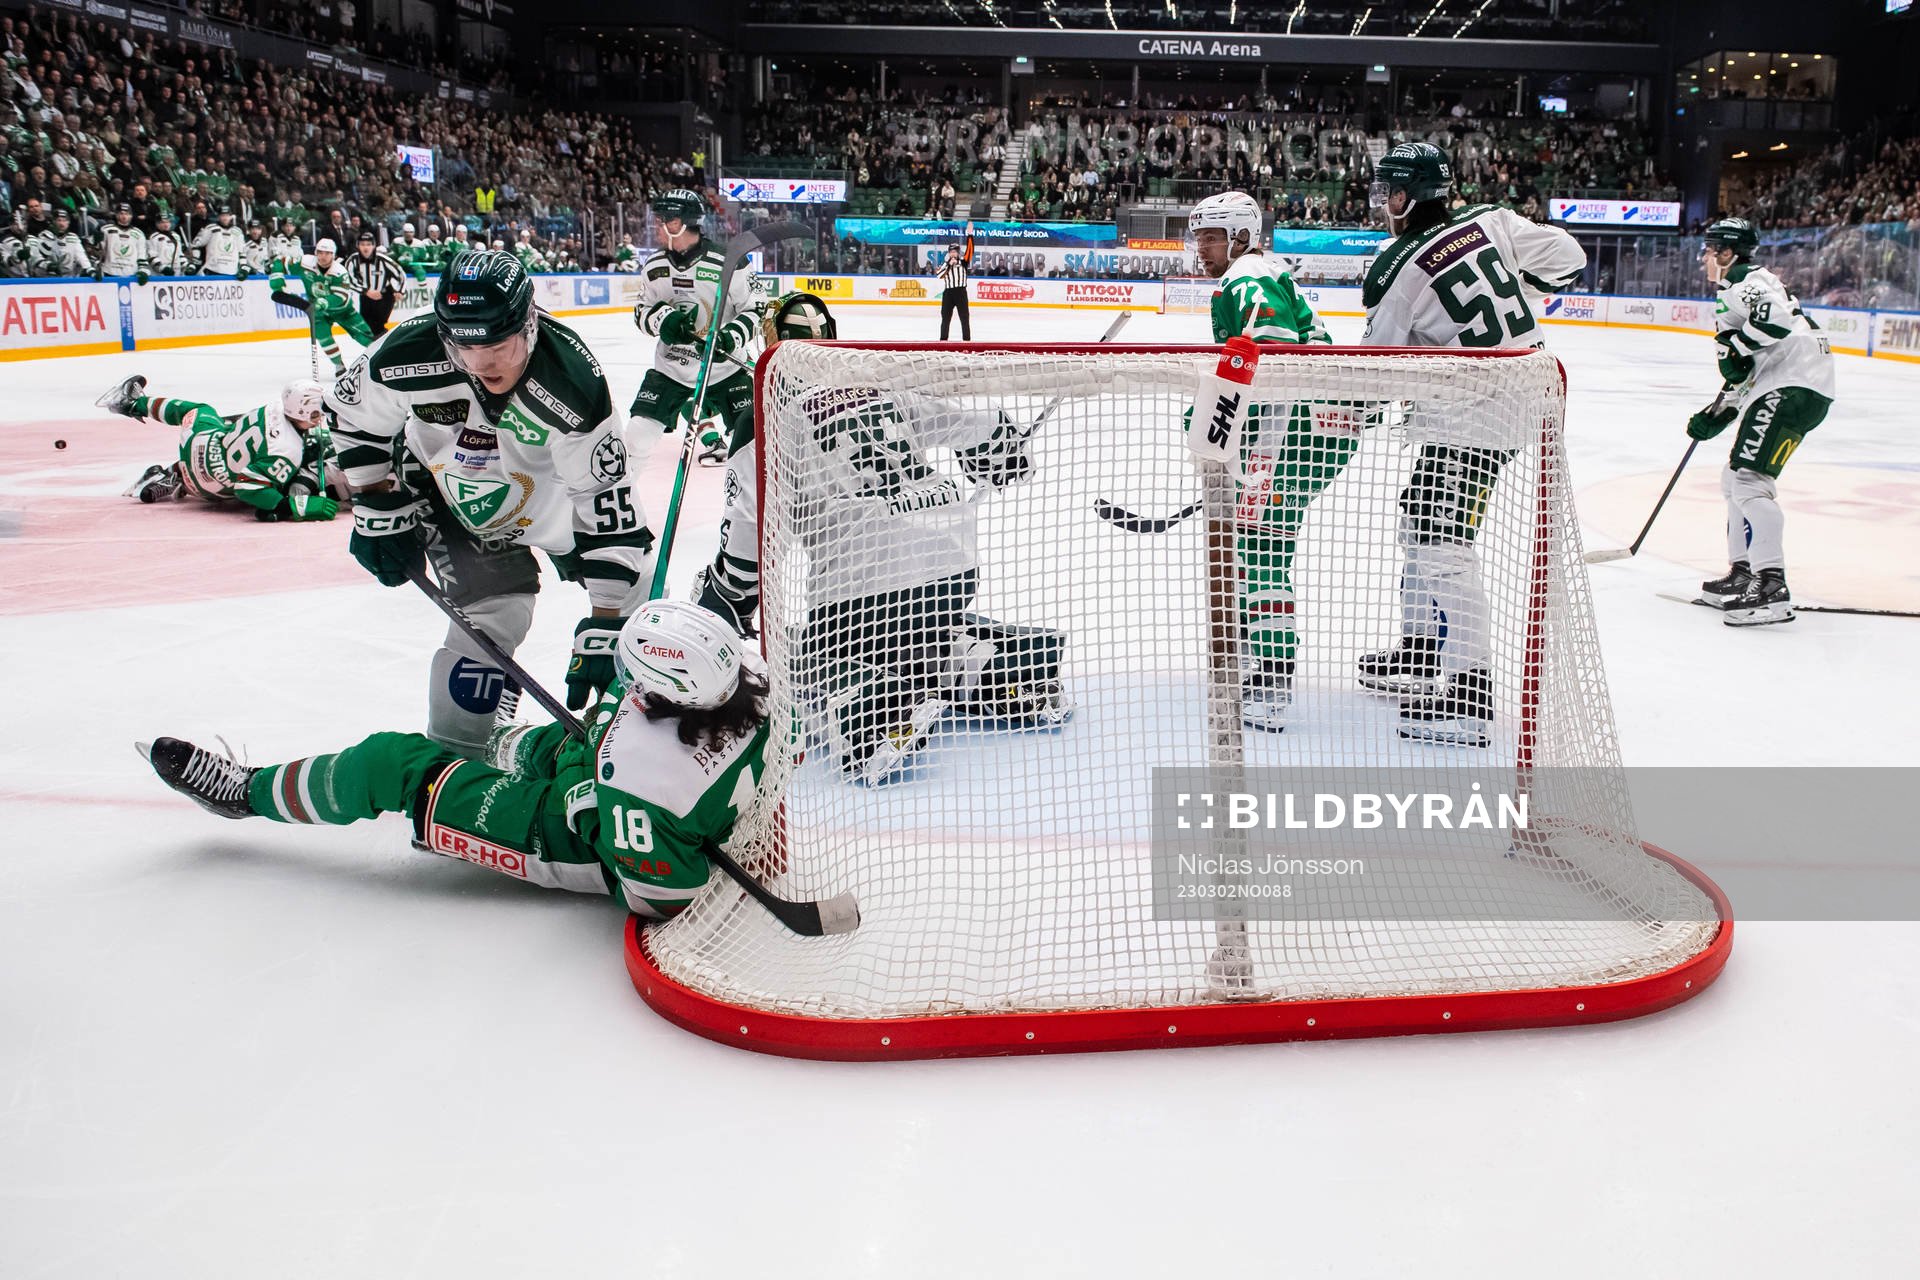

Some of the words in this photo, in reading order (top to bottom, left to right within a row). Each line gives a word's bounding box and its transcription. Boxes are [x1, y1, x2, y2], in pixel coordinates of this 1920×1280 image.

[1138, 38, 1204, 56] CATENA
[1209, 41, 1261, 57] Arena
[806, 192, 834, 200] SPORT
[807, 184, 835, 192] INTER
[1578, 203, 1607, 212] INTER
[1641, 206, 1669, 214] INTER
[1577, 212, 1606, 220] SPORT
[1640, 213, 1668, 221] SPORT
[976, 229, 987, 237] NY
[1012, 230, 1022, 238] AV
[1023, 229, 1049, 238] ŠKODA
[1426, 230, 1484, 269] LÖFBERGS
[1063, 250, 1184, 276] SKÅNEPORTAR
[806, 278, 832, 291] MVB
[1066, 284, 1134, 296] FLYTGOLV
[176, 285, 244, 301] OVERGAARD
[1071, 295, 1120, 303] LANDSKRONA
[1430, 246, 1536, 348] 59
[1564, 297, 1595, 307] INTER
[177, 303, 245, 319] SOLUTIONS
[1563, 307, 1594, 319] SPORT
[450, 327, 487, 336] KEWAB
[501, 409, 541, 442] coop
[1208, 391, 1241, 450] SHL
[267, 457, 293, 484] 56
[459, 482, 480, 501] F
[470, 496, 494, 515] BK
[593, 486, 637, 534] 55
[354, 513, 415, 532] CCM
[642, 644, 685, 660] CATENA
[717, 647, 728, 662] 18
[612, 804, 655, 854] 18
[441, 833, 520, 872] ER-HO
